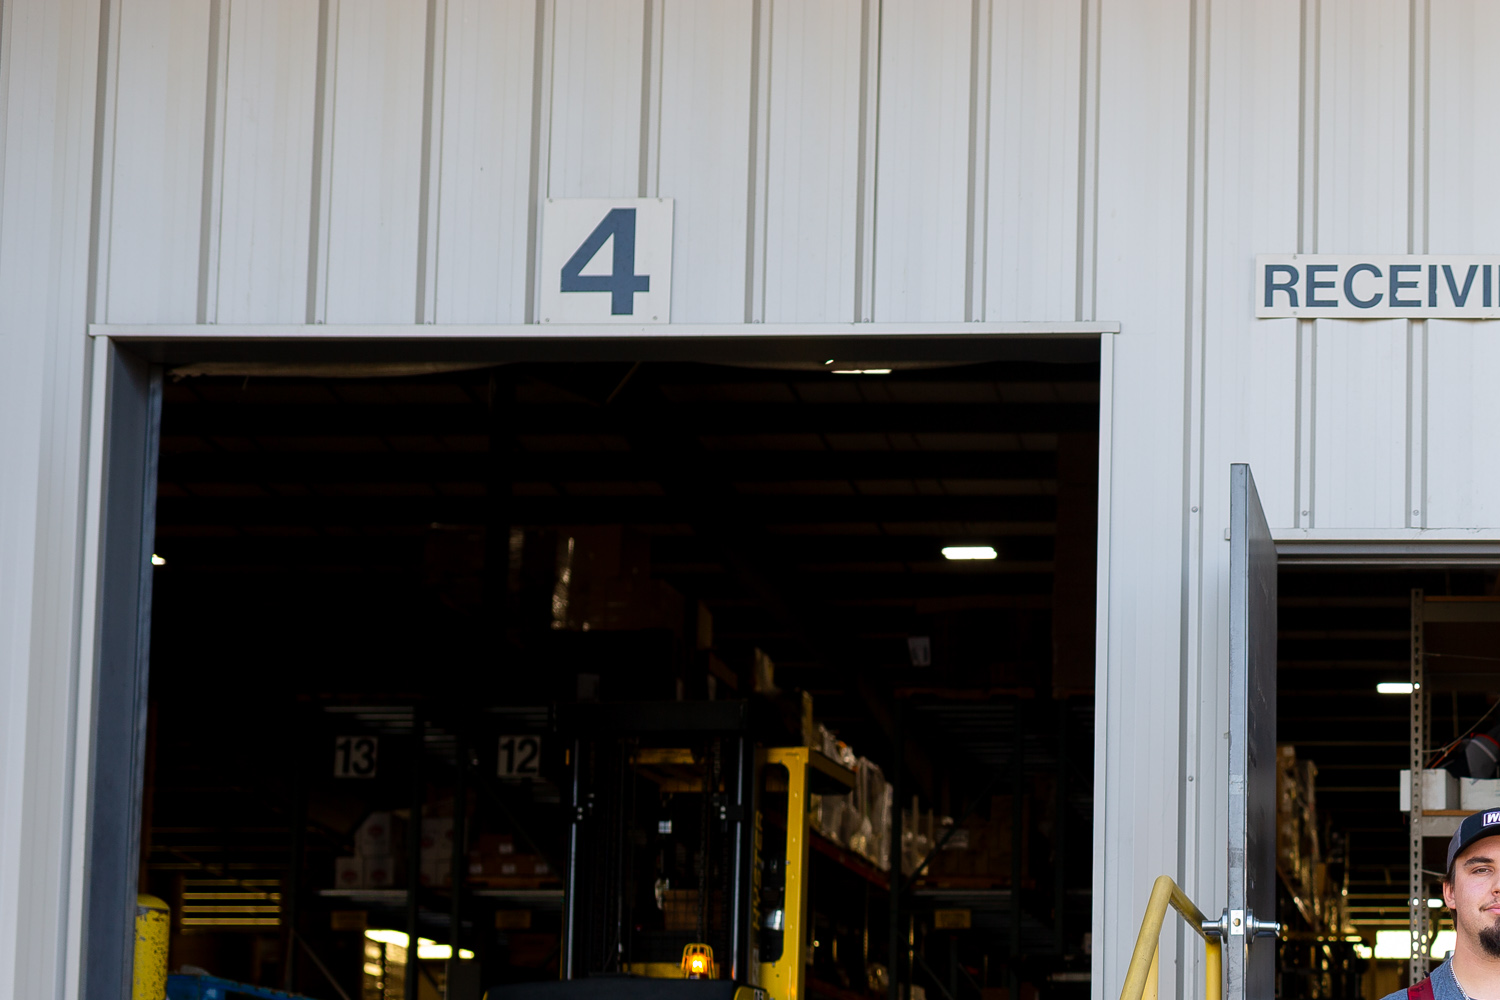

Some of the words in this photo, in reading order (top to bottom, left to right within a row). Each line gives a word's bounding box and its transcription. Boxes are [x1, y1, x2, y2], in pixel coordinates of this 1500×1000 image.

[560, 208, 650, 316] 4
[338, 739, 376, 775] 13
[501, 739, 538, 774] 12
